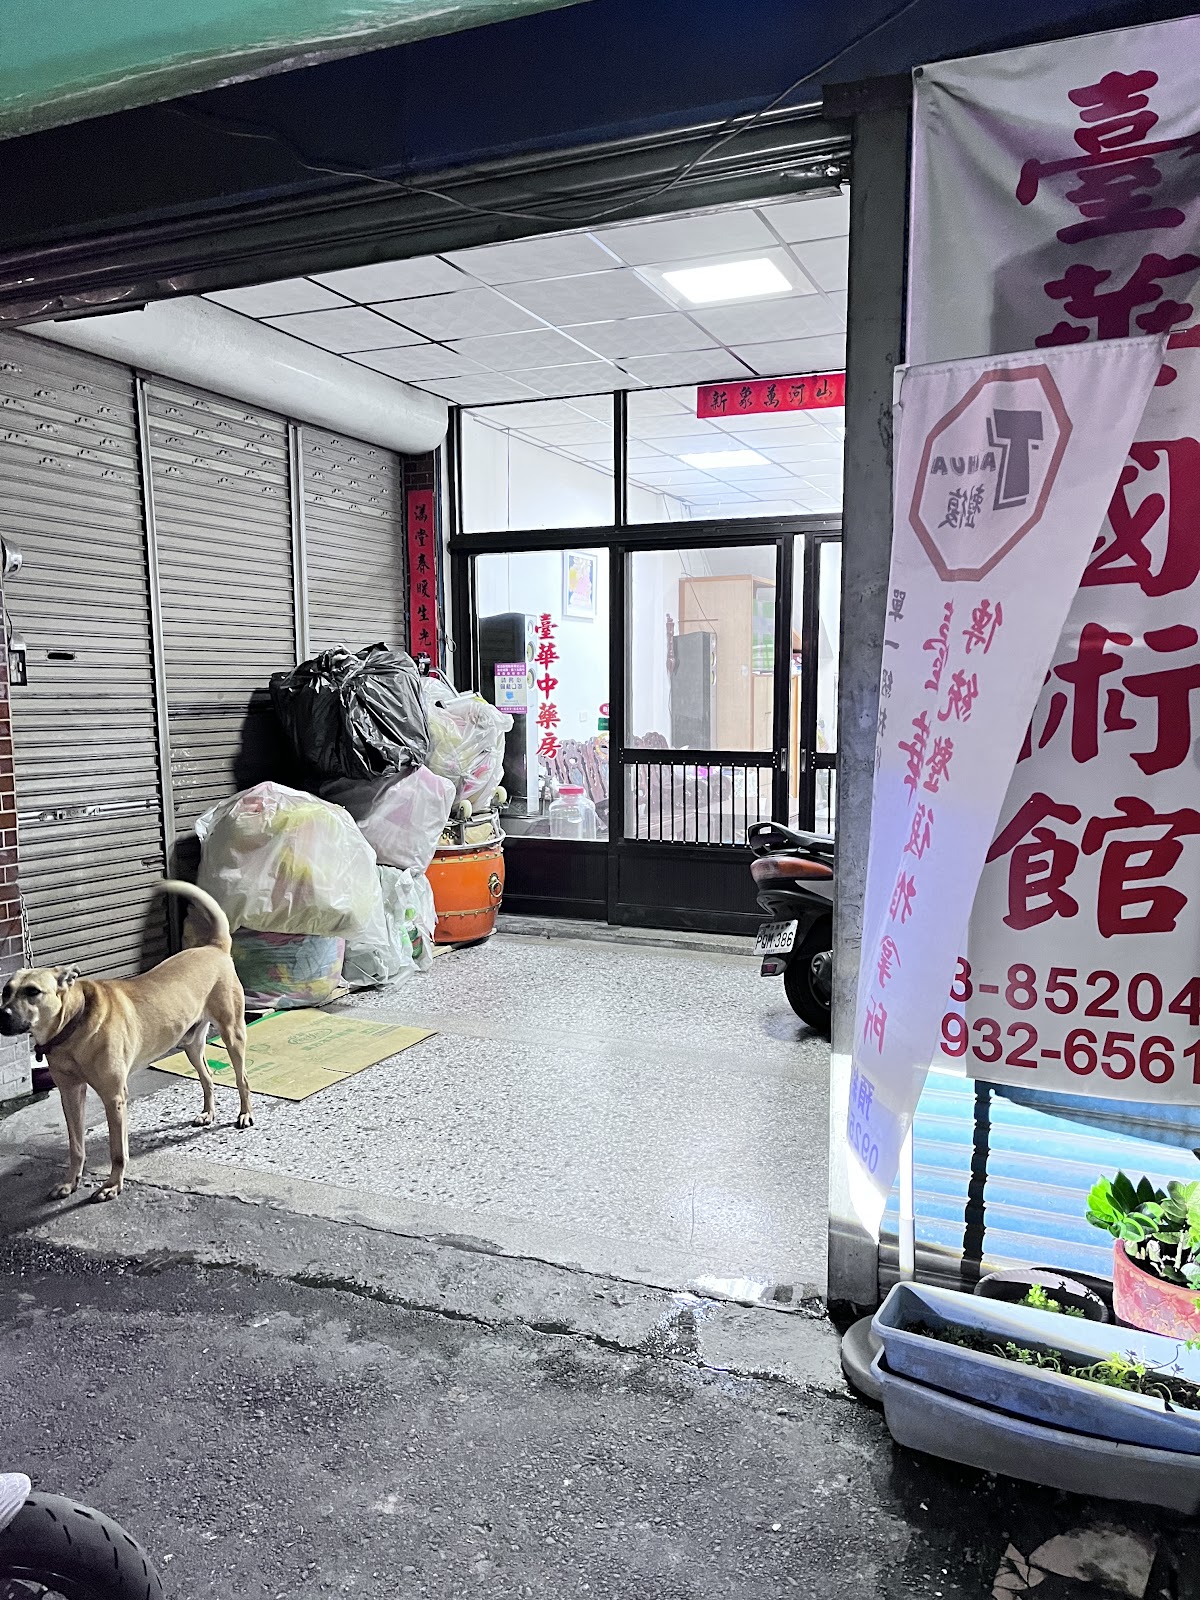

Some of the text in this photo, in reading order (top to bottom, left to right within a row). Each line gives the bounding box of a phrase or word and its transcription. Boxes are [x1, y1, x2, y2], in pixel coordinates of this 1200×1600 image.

[534, 612, 562, 760] 臺華中藥房
